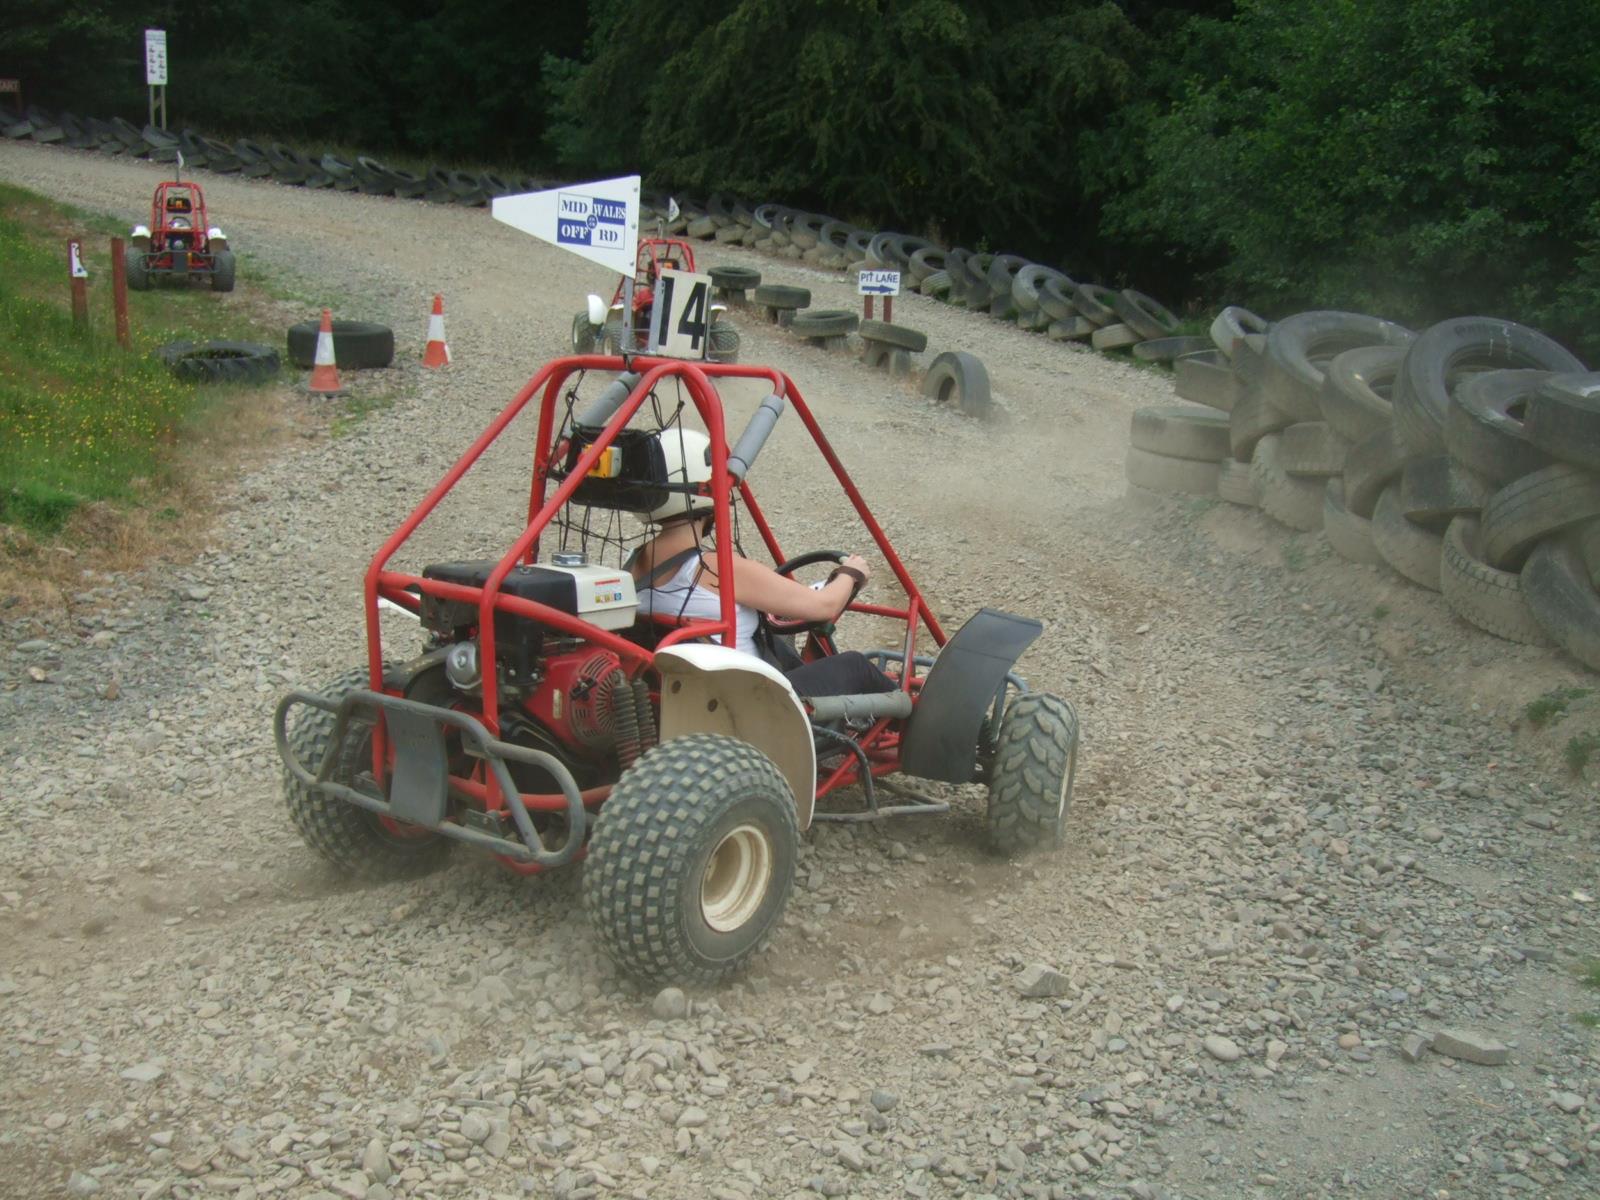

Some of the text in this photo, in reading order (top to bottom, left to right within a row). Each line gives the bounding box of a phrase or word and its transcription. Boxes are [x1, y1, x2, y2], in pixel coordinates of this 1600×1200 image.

[562, 200, 626, 219] MID WALES
[561, 224, 589, 240] OFF
[860, 272, 899, 283] PIT LANE
[658, 276, 707, 350] 14
